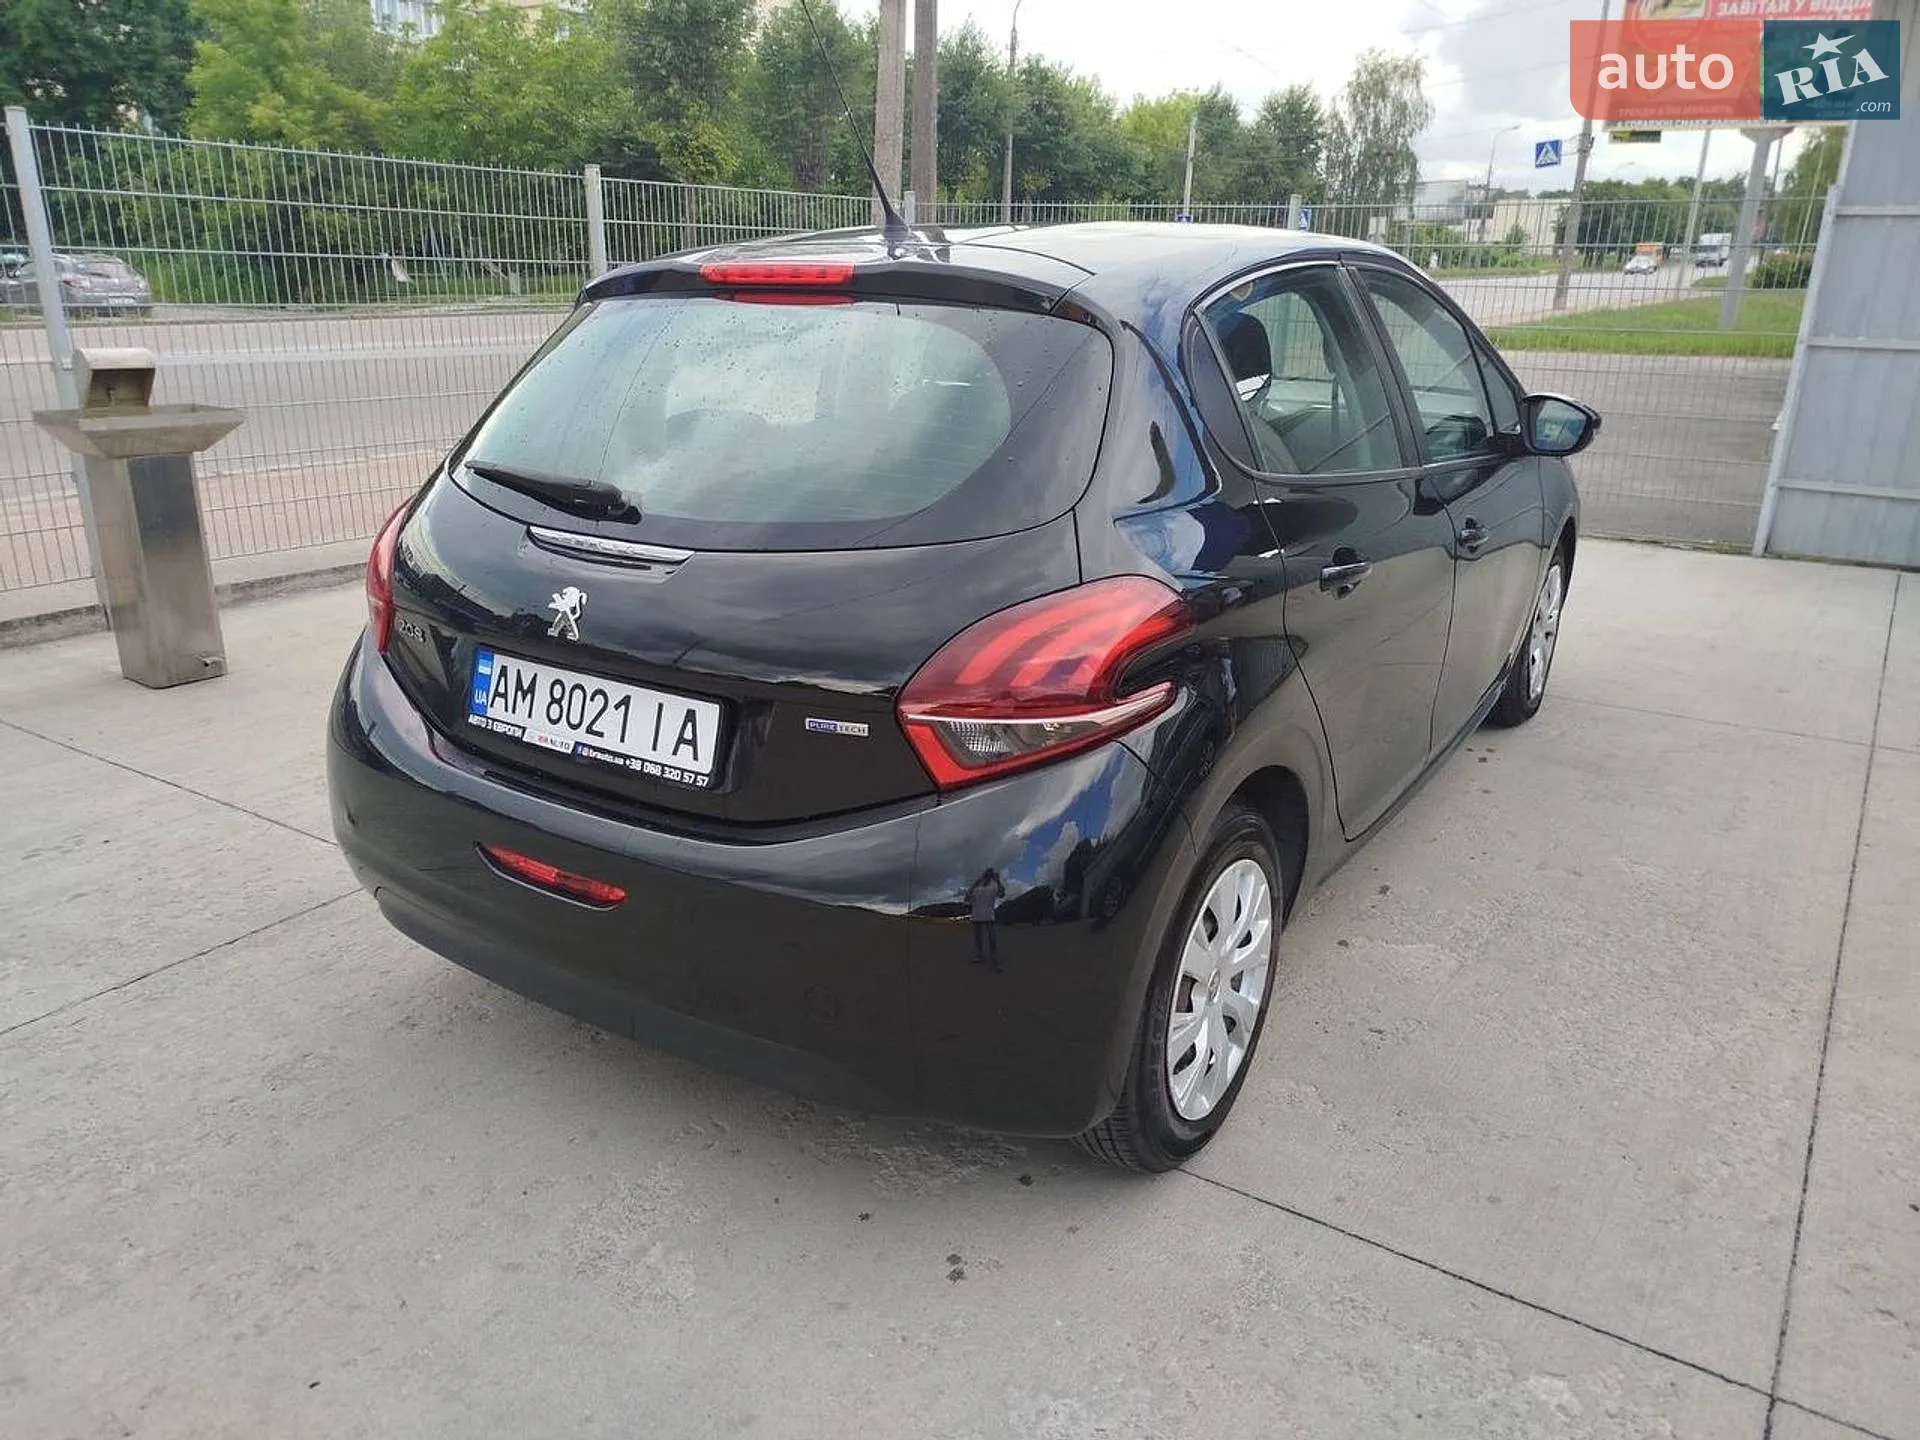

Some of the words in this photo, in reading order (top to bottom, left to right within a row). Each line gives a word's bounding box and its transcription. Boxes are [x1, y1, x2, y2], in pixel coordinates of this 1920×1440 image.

[474, 688, 487, 706] UA
[489, 664, 538, 719] AM
[545, 678, 632, 744] 8021
[651, 702, 699, 762] IA
[682, 773, 695, 785] 57
[696, 775, 709, 787] 57
